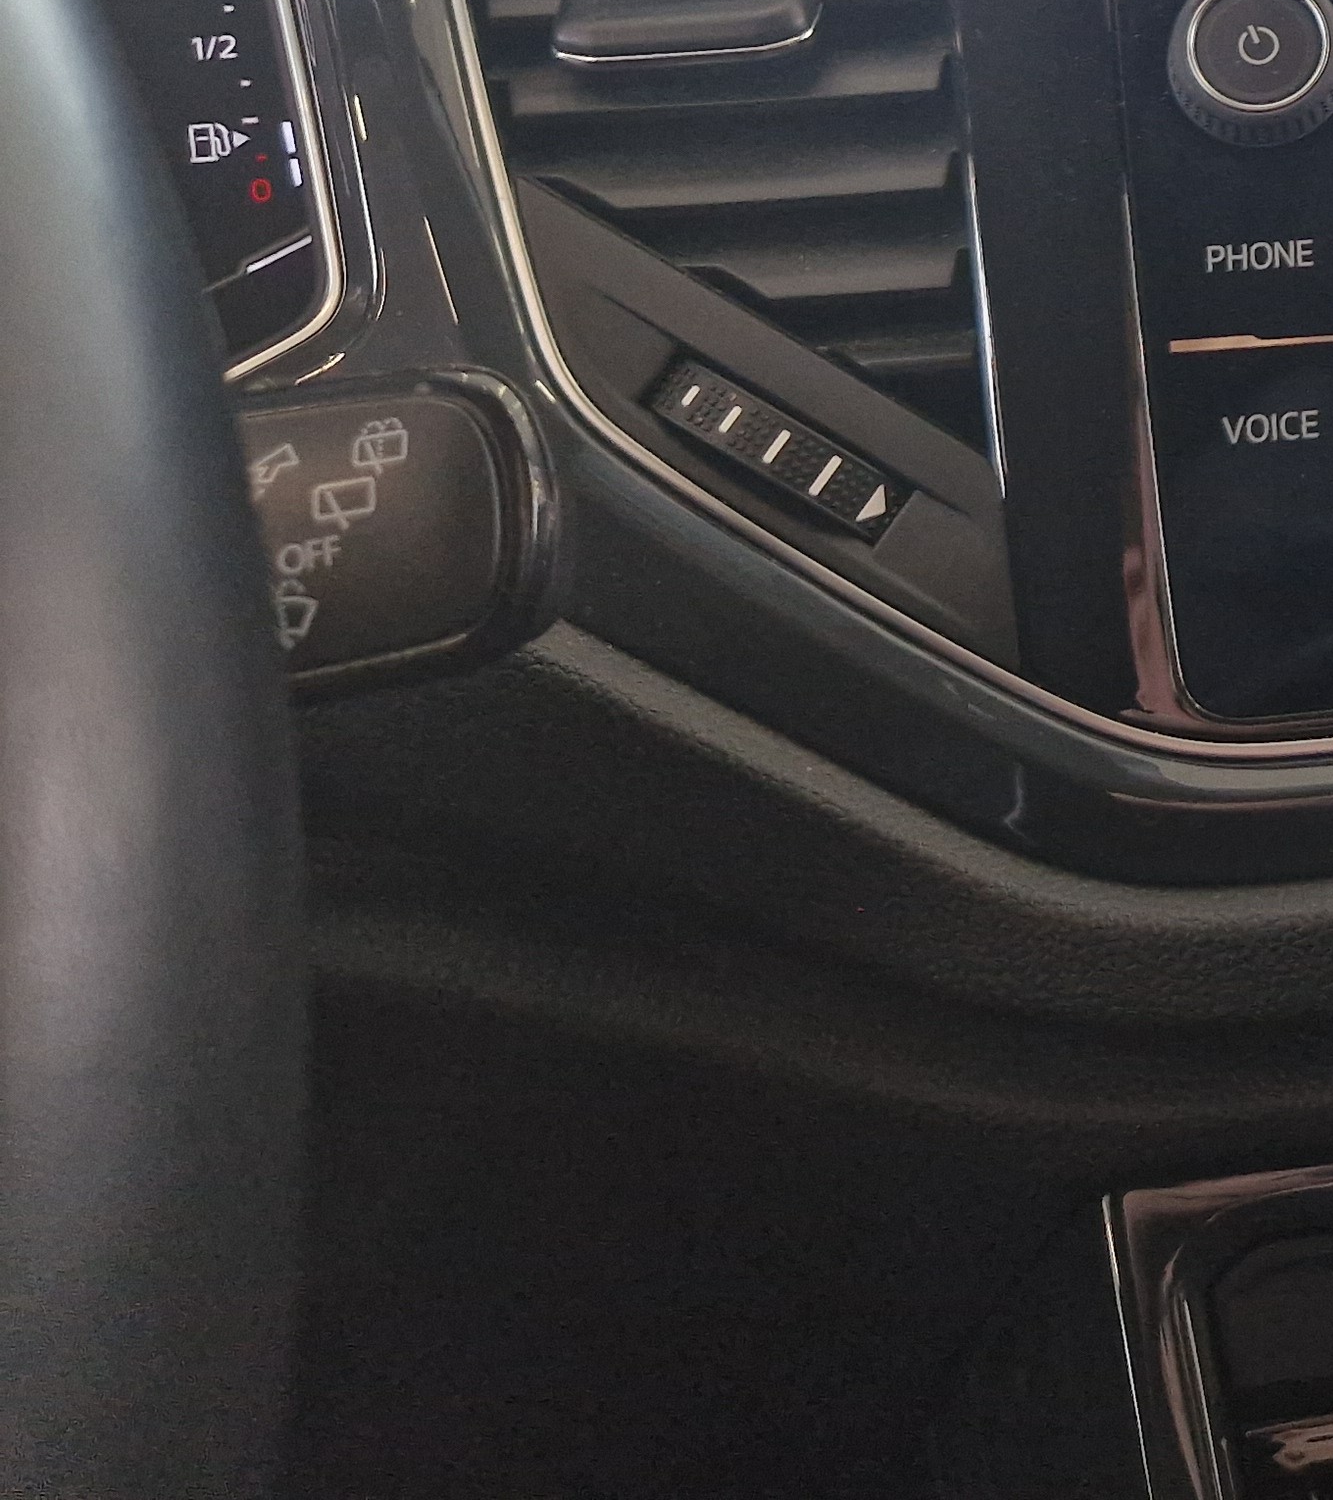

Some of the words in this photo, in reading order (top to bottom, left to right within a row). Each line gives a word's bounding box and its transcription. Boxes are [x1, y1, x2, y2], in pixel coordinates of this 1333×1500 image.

[191, 35, 238, 61] 1/2
[1206, 239, 1315, 273] PHONE
[1222, 409, 1320, 445] VOICE
